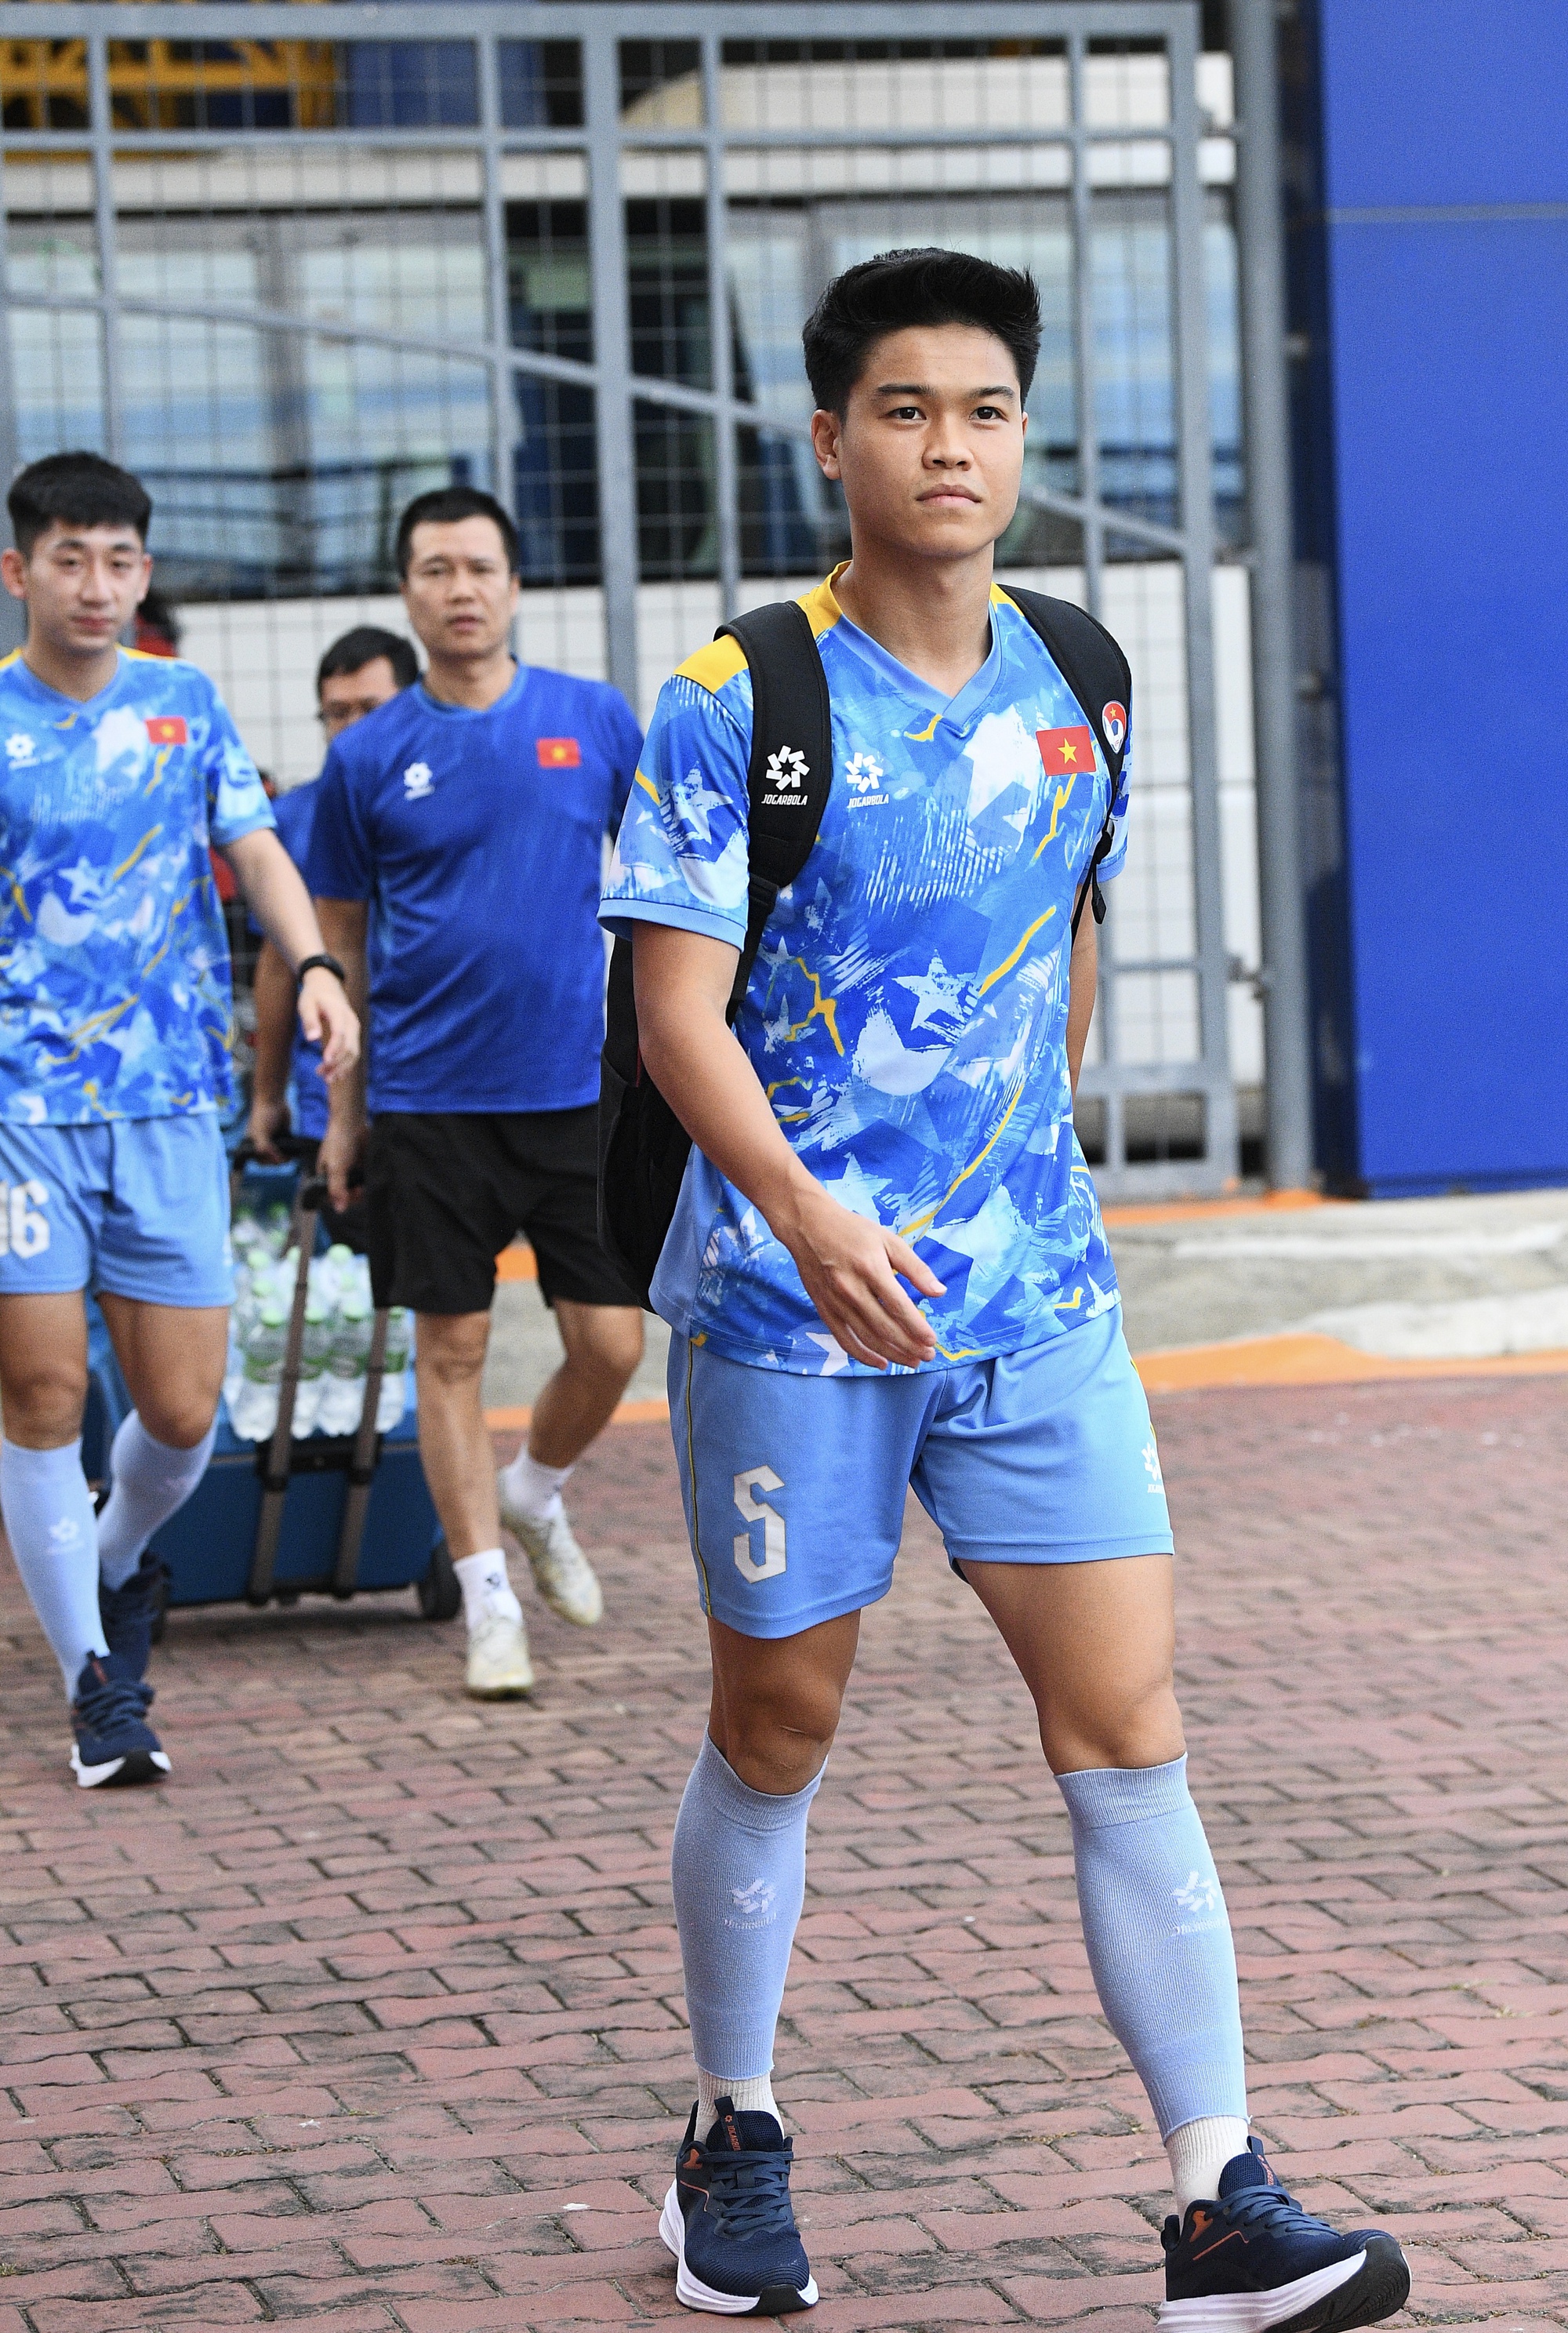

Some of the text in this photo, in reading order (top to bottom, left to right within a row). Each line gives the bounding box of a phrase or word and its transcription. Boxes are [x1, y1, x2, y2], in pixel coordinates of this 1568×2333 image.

[761, 794, 808, 805] JOGARBOLA
[847, 794, 889, 809] JOGARBOLA
[727, 2125, 741, 2151] JOGARBOL
